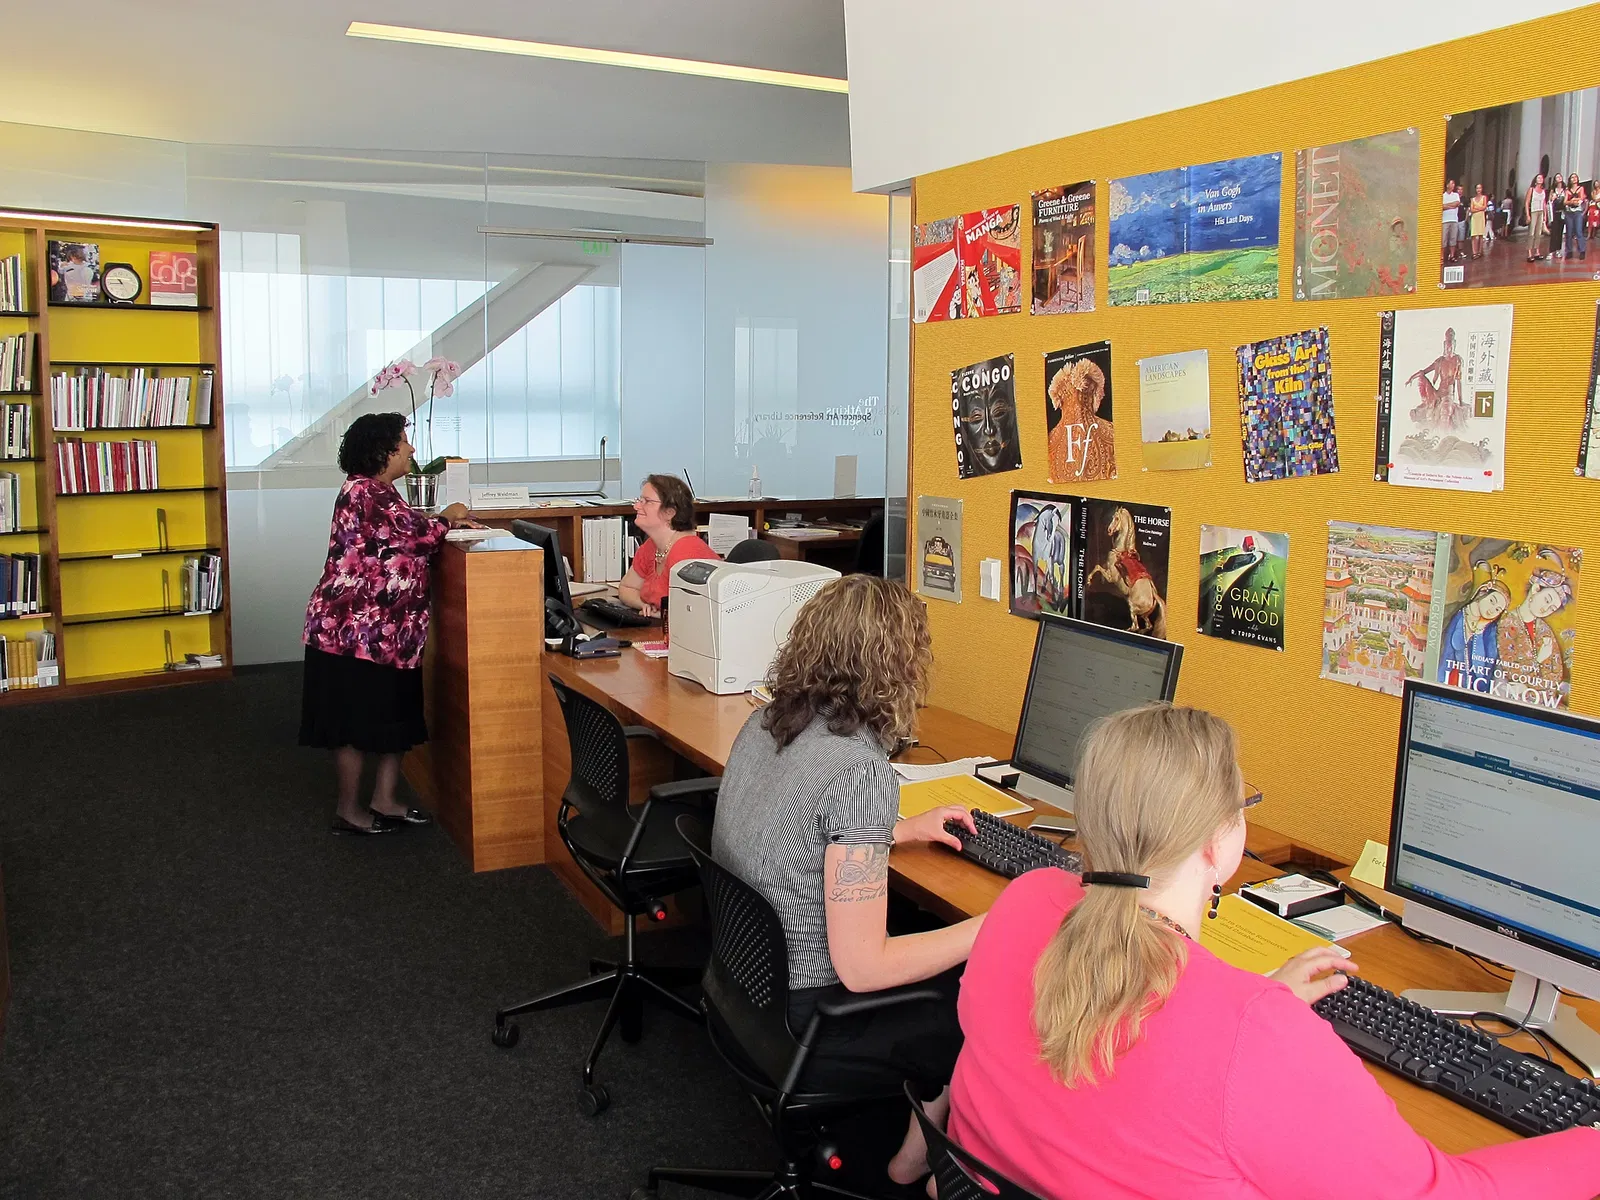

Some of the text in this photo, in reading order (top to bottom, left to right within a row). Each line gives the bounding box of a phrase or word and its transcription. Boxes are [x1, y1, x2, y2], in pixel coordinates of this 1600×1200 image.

[1205, 184, 1240, 199] Van Gogh
[1038, 192, 1090, 208] Greene & Greene
[1198, 202, 1232, 214] in Auvers
[1038, 202, 1079, 218] FURNITURE
[1214, 214, 1254, 226] His Last Days
[1310, 148, 1340, 298] MONET
[966, 214, 1004, 244] MANGA
[1254, 344, 1318, 370] Glass Art
[1479, 332, 1496, 384] 海外藏
[1144, 362, 1179, 374] AMERICAN
[1144, 370, 1186, 382] LANDSCAPES
[1267, 364, 1306, 379] from the
[962, 365, 1010, 392] CONGO
[1275, 378, 1302, 394] Kiln
[1478, 396, 1492, 414] 下
[952, 382, 964, 462] CONGO
[1064, 423, 1098, 476] Ff
[1134, 516, 1170, 528] THE HORSE
[1230, 588, 1280, 608] GRANT
[1230, 604, 1279, 626] WOOD
[1428, 589, 1442, 650] LUCKNOW
[1238, 630, 1256, 639] TRIPP
[1257, 634, 1276, 644] EVANS
[1472, 654, 1494, 664] INDIA'S
[1496, 658, 1520, 668] FABLED
[1446, 660, 1562, 690] THE ART OF COURTLY
[1444, 670, 1563, 709] LUCKNOW
[1497, 926, 1519, 939] DELL
[1522, 1060, 1545, 1073] DELL
